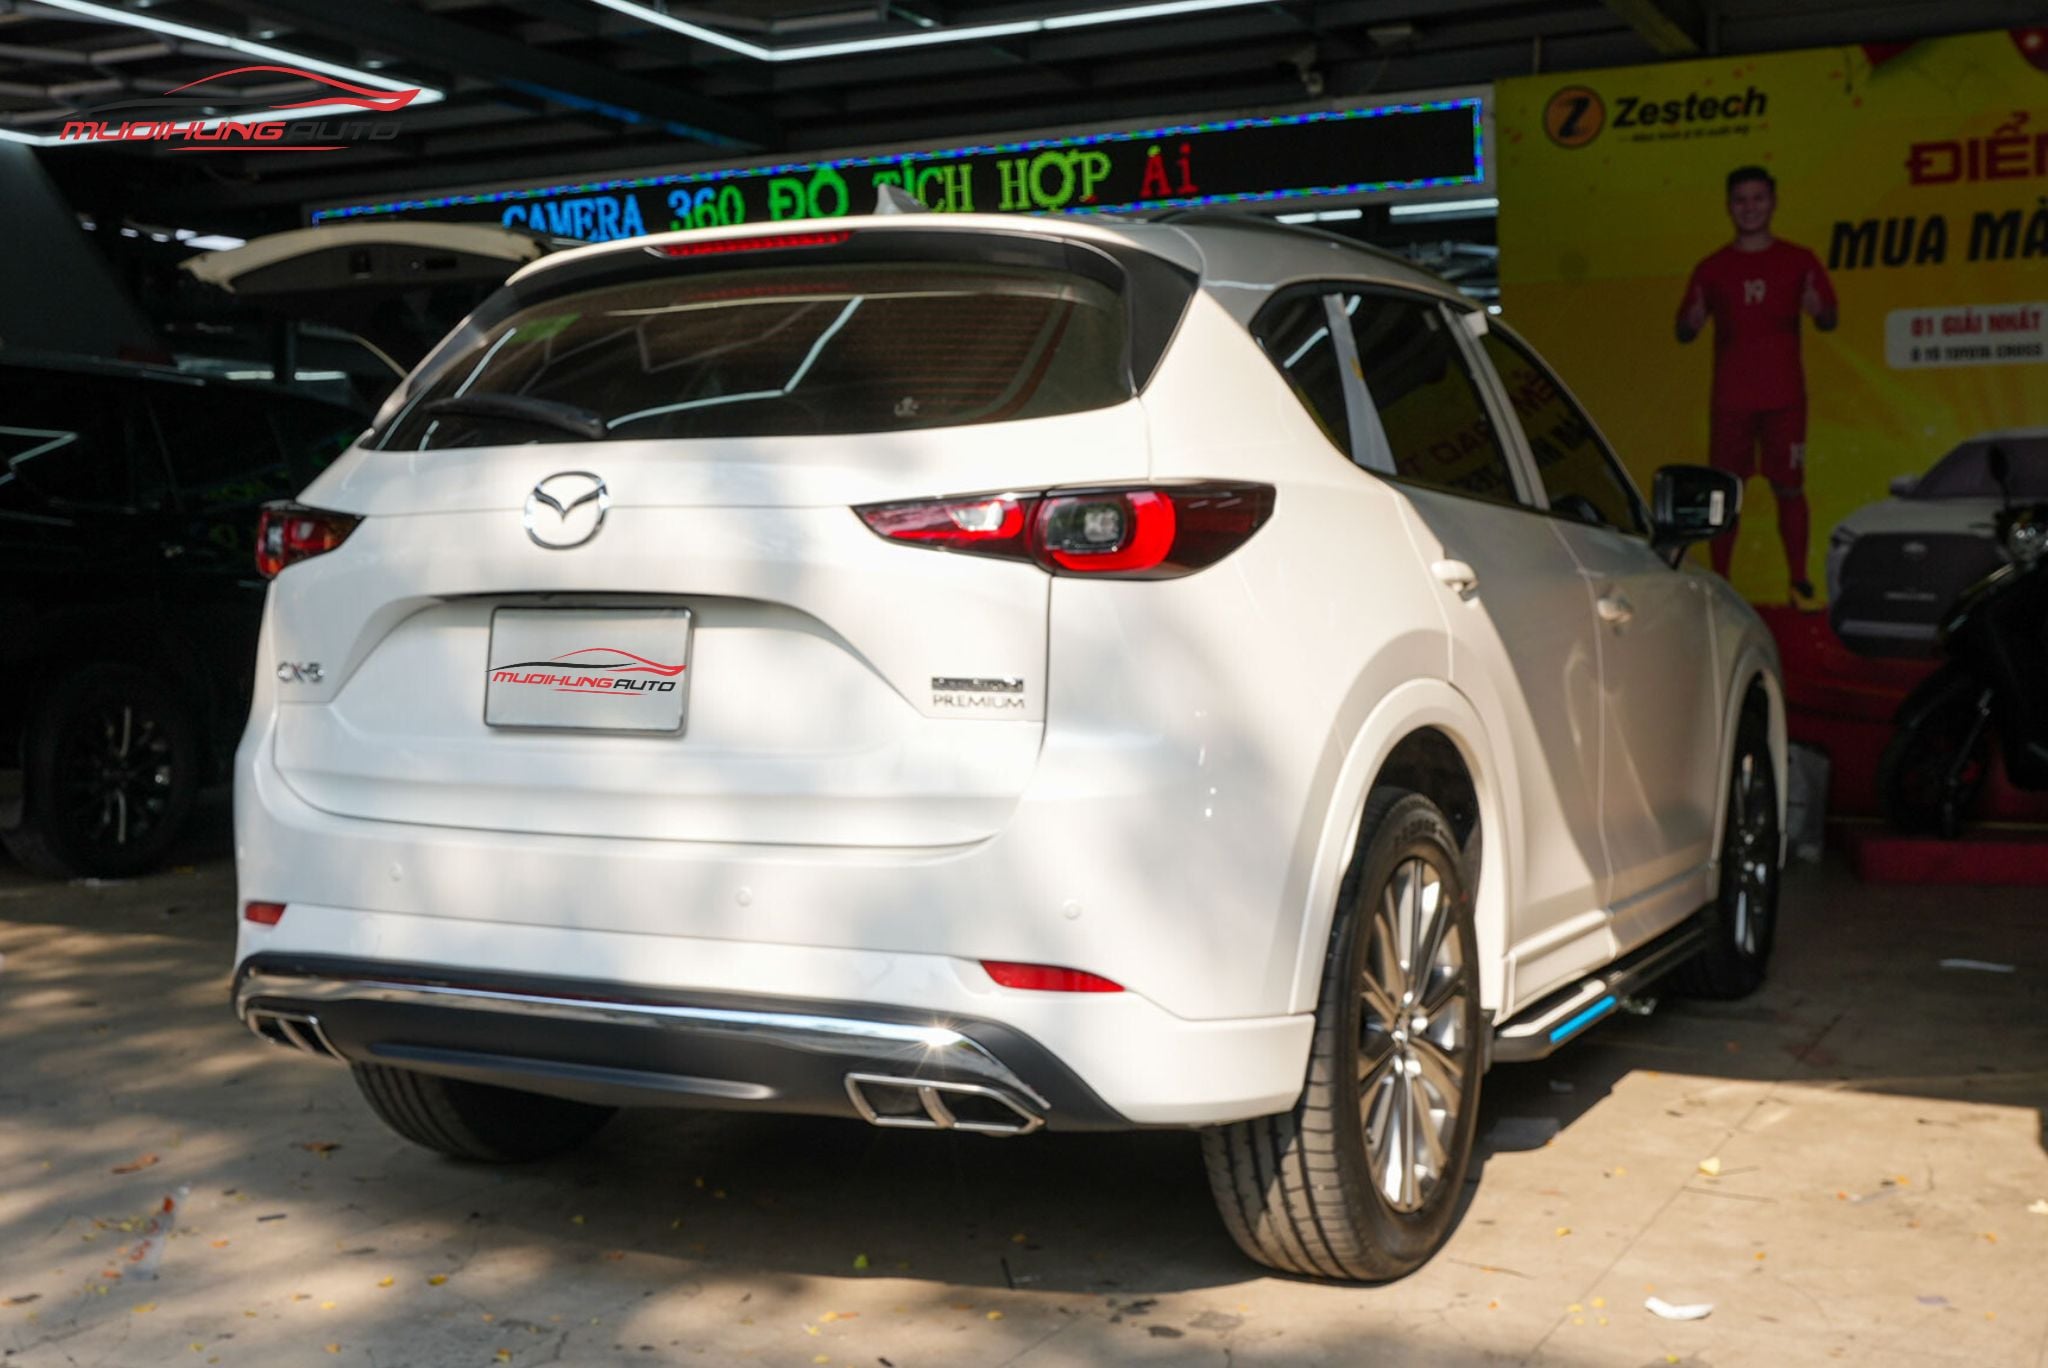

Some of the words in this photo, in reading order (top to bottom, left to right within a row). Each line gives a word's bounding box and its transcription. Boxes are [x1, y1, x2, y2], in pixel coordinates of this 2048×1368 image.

[1613, 86, 1768, 128] Zestech
[1906, 111, 2048, 185] ĐIỂ
[501, 192, 648, 243] CAMERA
[667, 184, 746, 232] 360
[996, 148, 1112, 211] HỢP
[1829, 214, 1947, 270] MUA
[1743, 277, 1767, 305] 19
[277, 661, 325, 683] CX-5
[932, 694, 1025, 710] PREMIUM
